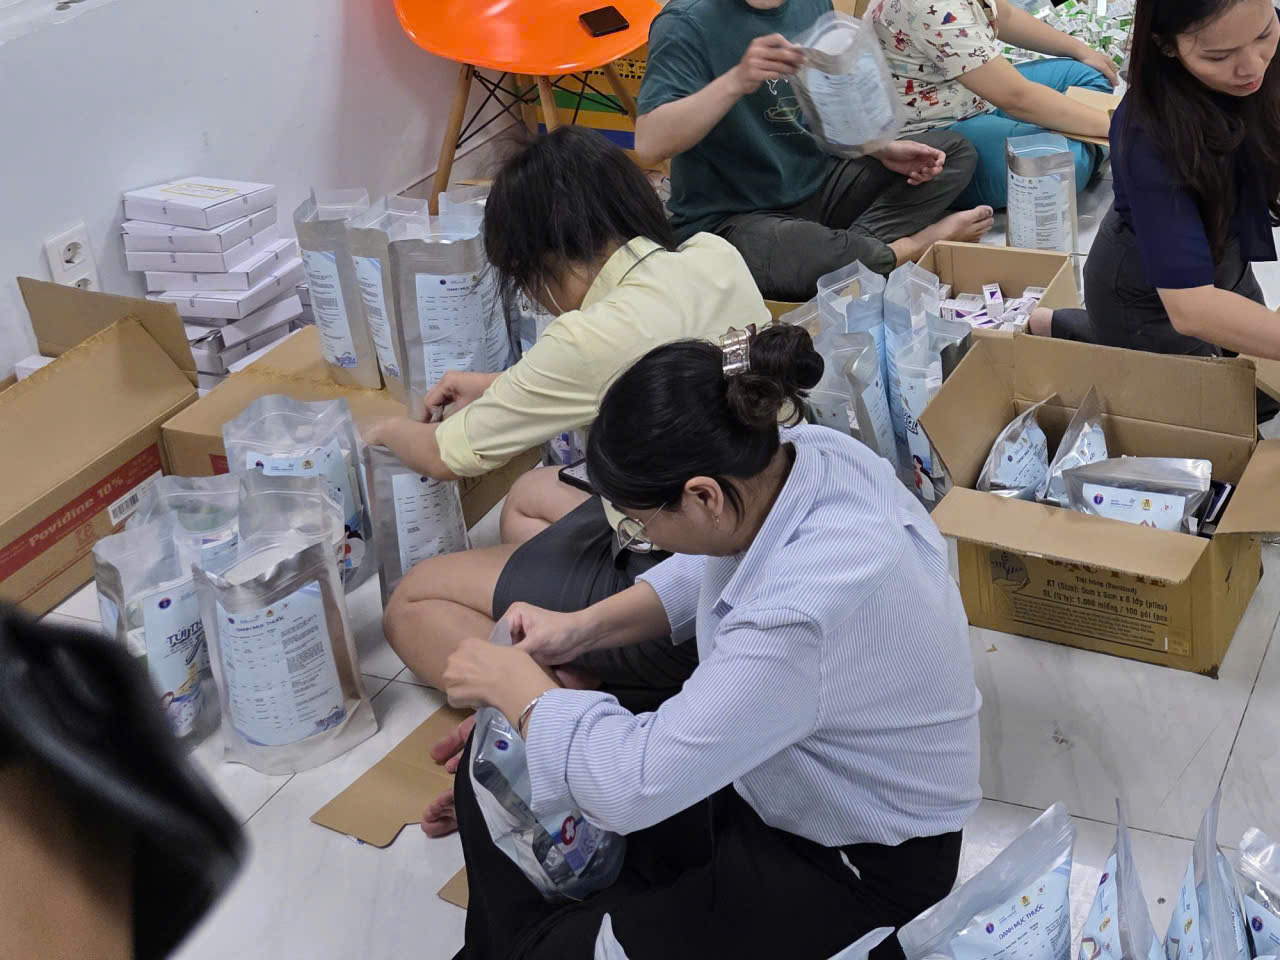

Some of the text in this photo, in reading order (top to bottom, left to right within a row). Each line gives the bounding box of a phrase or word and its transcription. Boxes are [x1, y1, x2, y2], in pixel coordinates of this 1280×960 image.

[29, 476, 125, 547] Povidine 10%
[1047, 579, 1055, 587] KT
[998, 903, 1045, 940] DANH MỤC THUỐC
